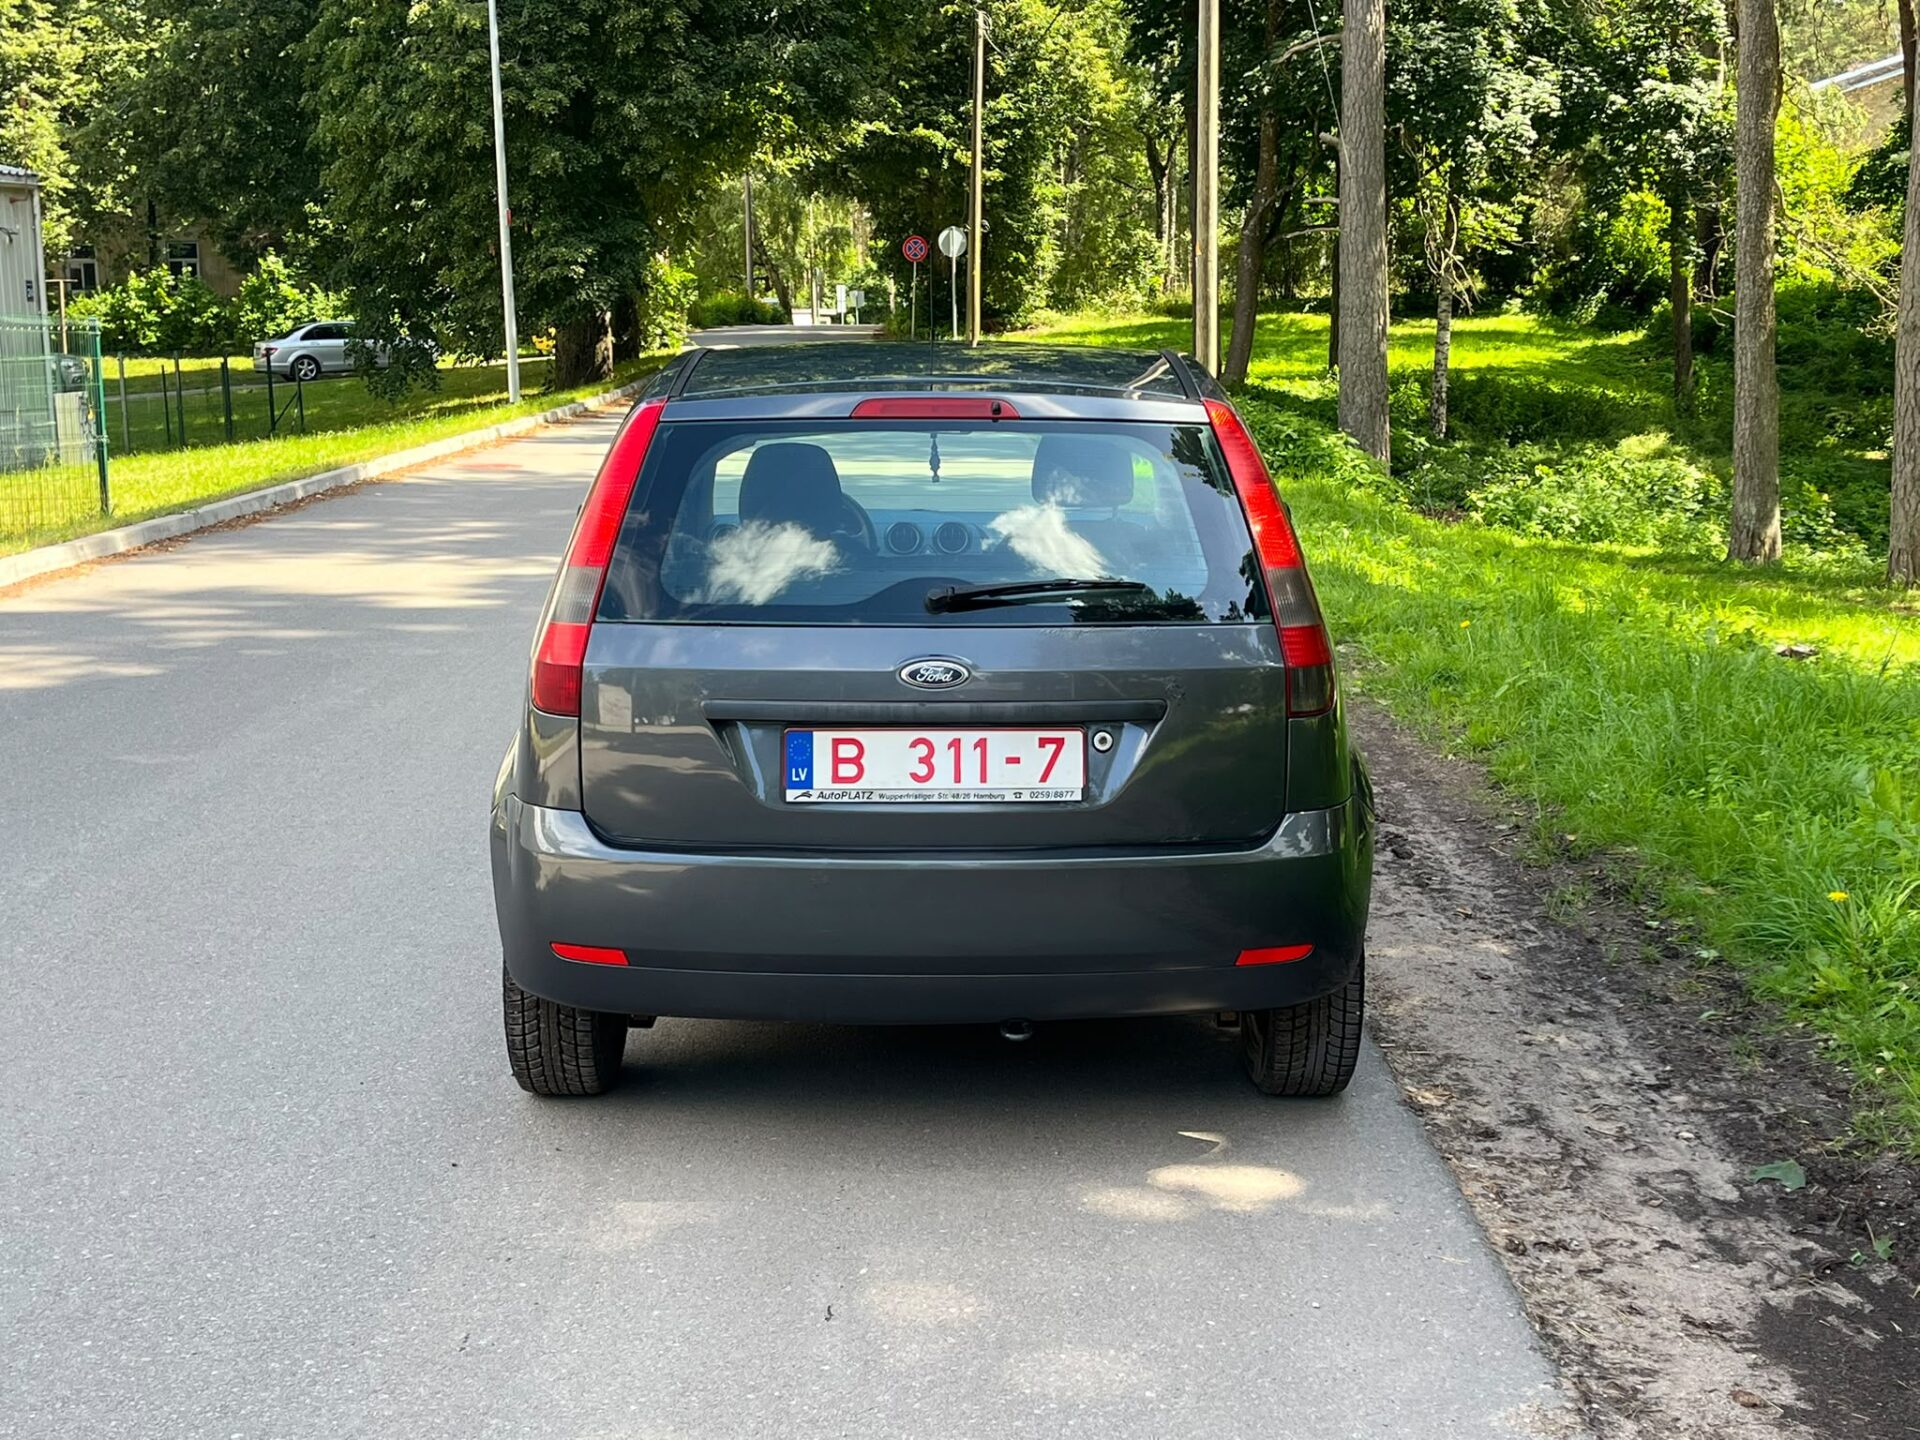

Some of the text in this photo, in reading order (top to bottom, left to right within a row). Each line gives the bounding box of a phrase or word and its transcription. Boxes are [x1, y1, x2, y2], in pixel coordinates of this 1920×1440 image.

[916, 665, 954, 682] Ford
[831, 738, 865, 784] B
[791, 768, 807, 781] LV
[816, 791, 874, 801] AutoPLATZ
[973, 792, 1005, 801] Hamburg
